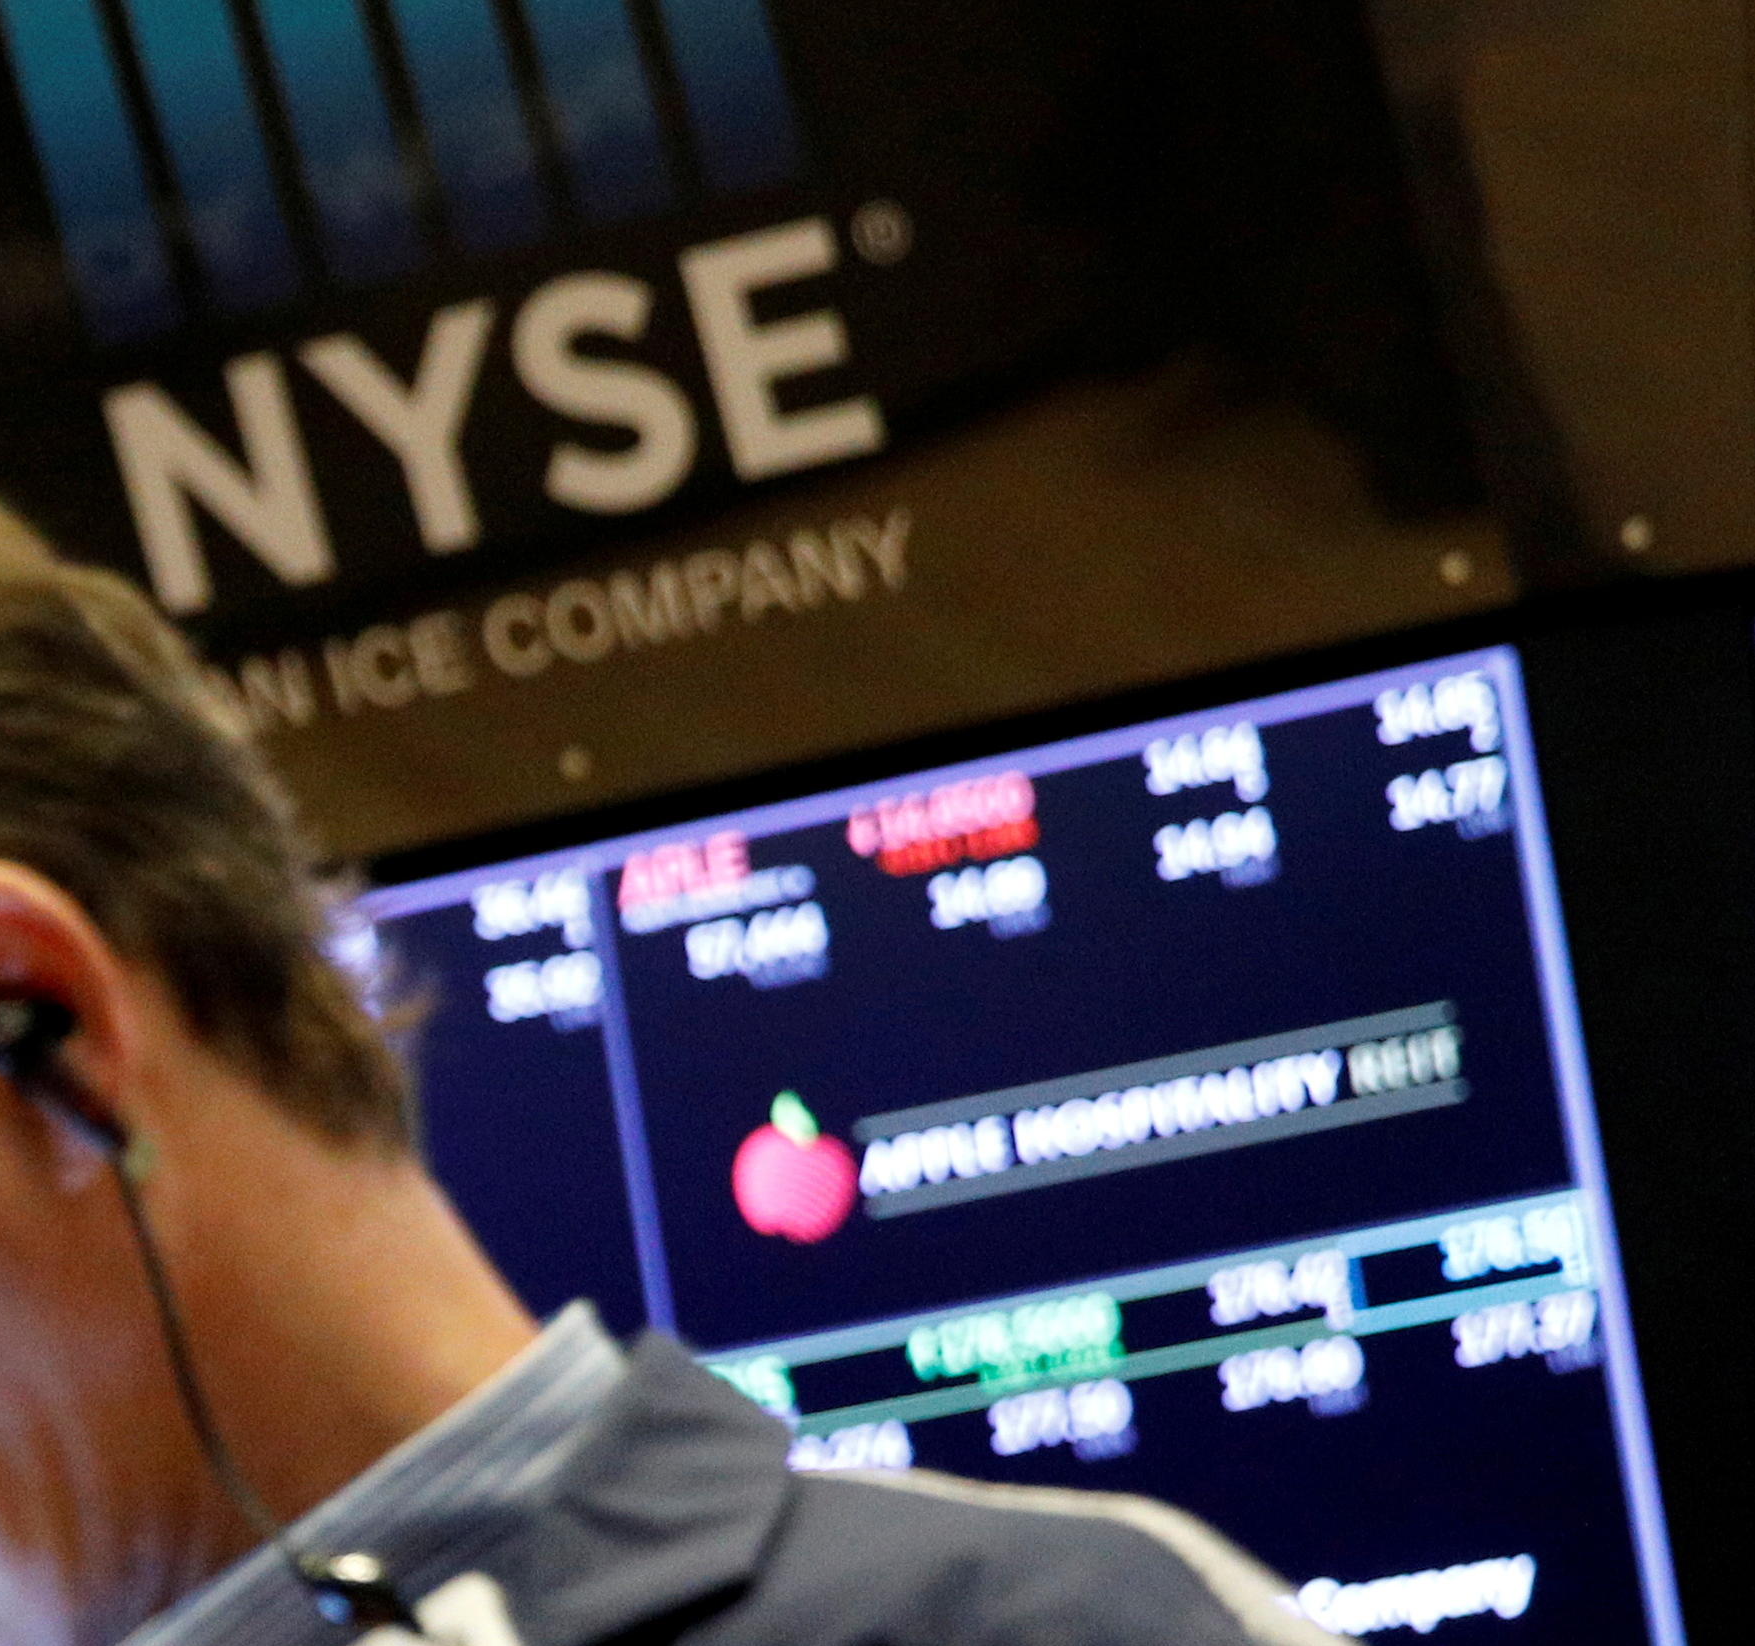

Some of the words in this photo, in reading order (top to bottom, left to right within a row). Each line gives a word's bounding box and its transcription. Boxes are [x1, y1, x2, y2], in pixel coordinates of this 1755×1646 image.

[101, 216, 884, 618] NYSE
[322, 610, 476, 716] ICE
[481, 506, 916, 678] COMPANY
[859, 1115, 1013, 1198] APPLE
[1013, 1048, 1343, 1166] HOSPITALITY
